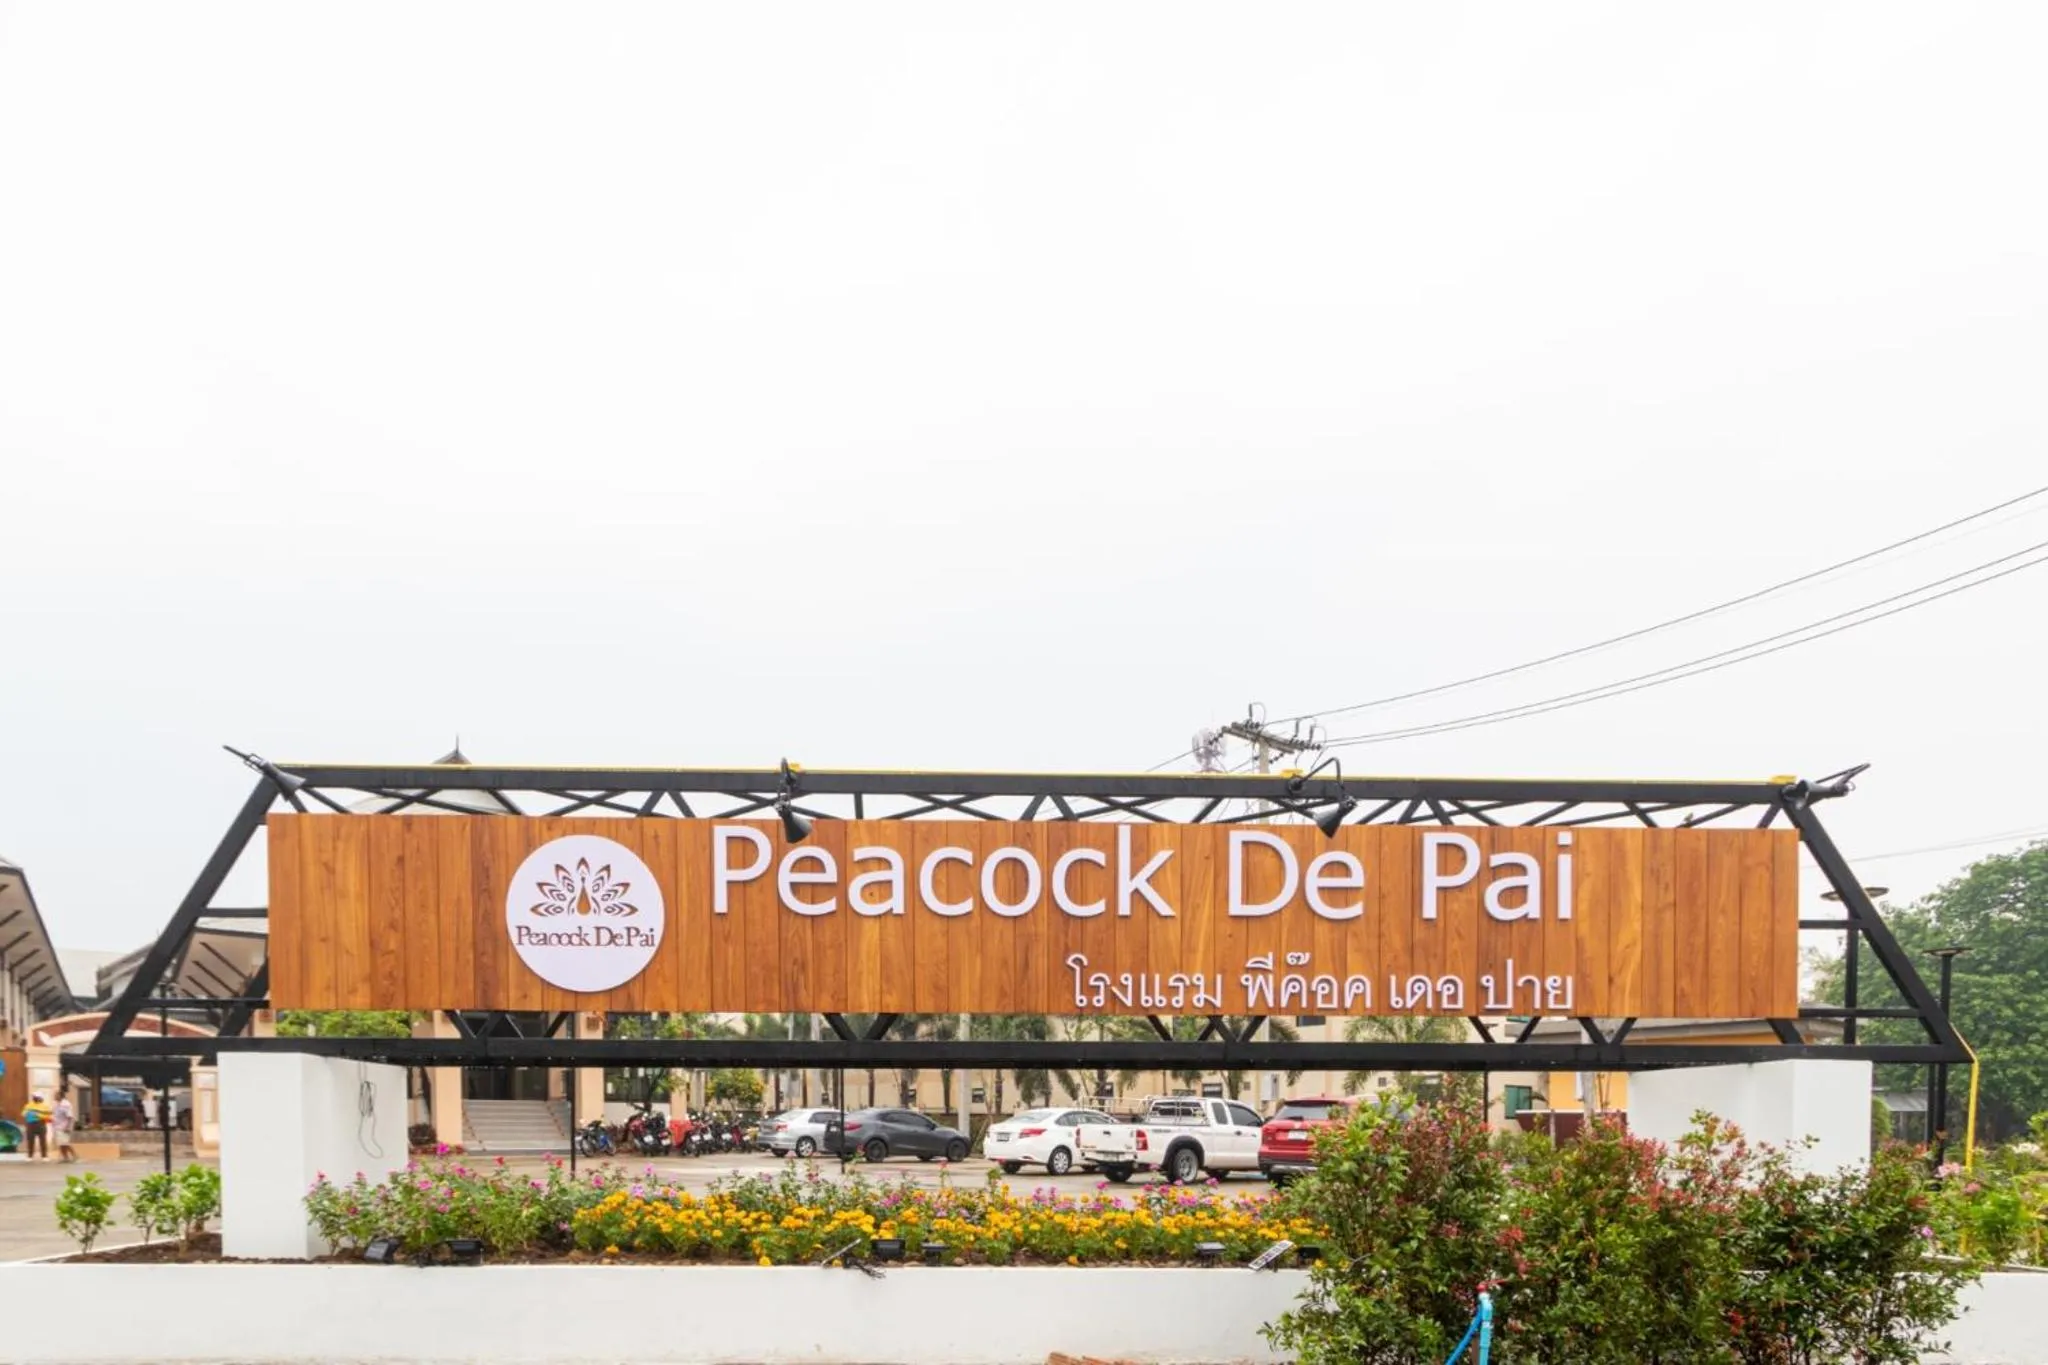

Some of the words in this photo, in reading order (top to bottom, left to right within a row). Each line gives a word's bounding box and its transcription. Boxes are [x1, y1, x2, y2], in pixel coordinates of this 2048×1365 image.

[711, 824, 1177, 920] Peacock
[1227, 831, 1365, 922] De
[1421, 832, 1574, 922] Pai
[516, 925, 592, 947] Peacock
[594, 926, 624, 947] De
[625, 926, 656, 948] Pai
[1066, 953, 1223, 1009] โรงแรม
[1240, 951, 1372, 1010] พีค๊อค
[1389, 975, 1465, 1010] เดอ
[1479, 958, 1574, 1011] ปาย
